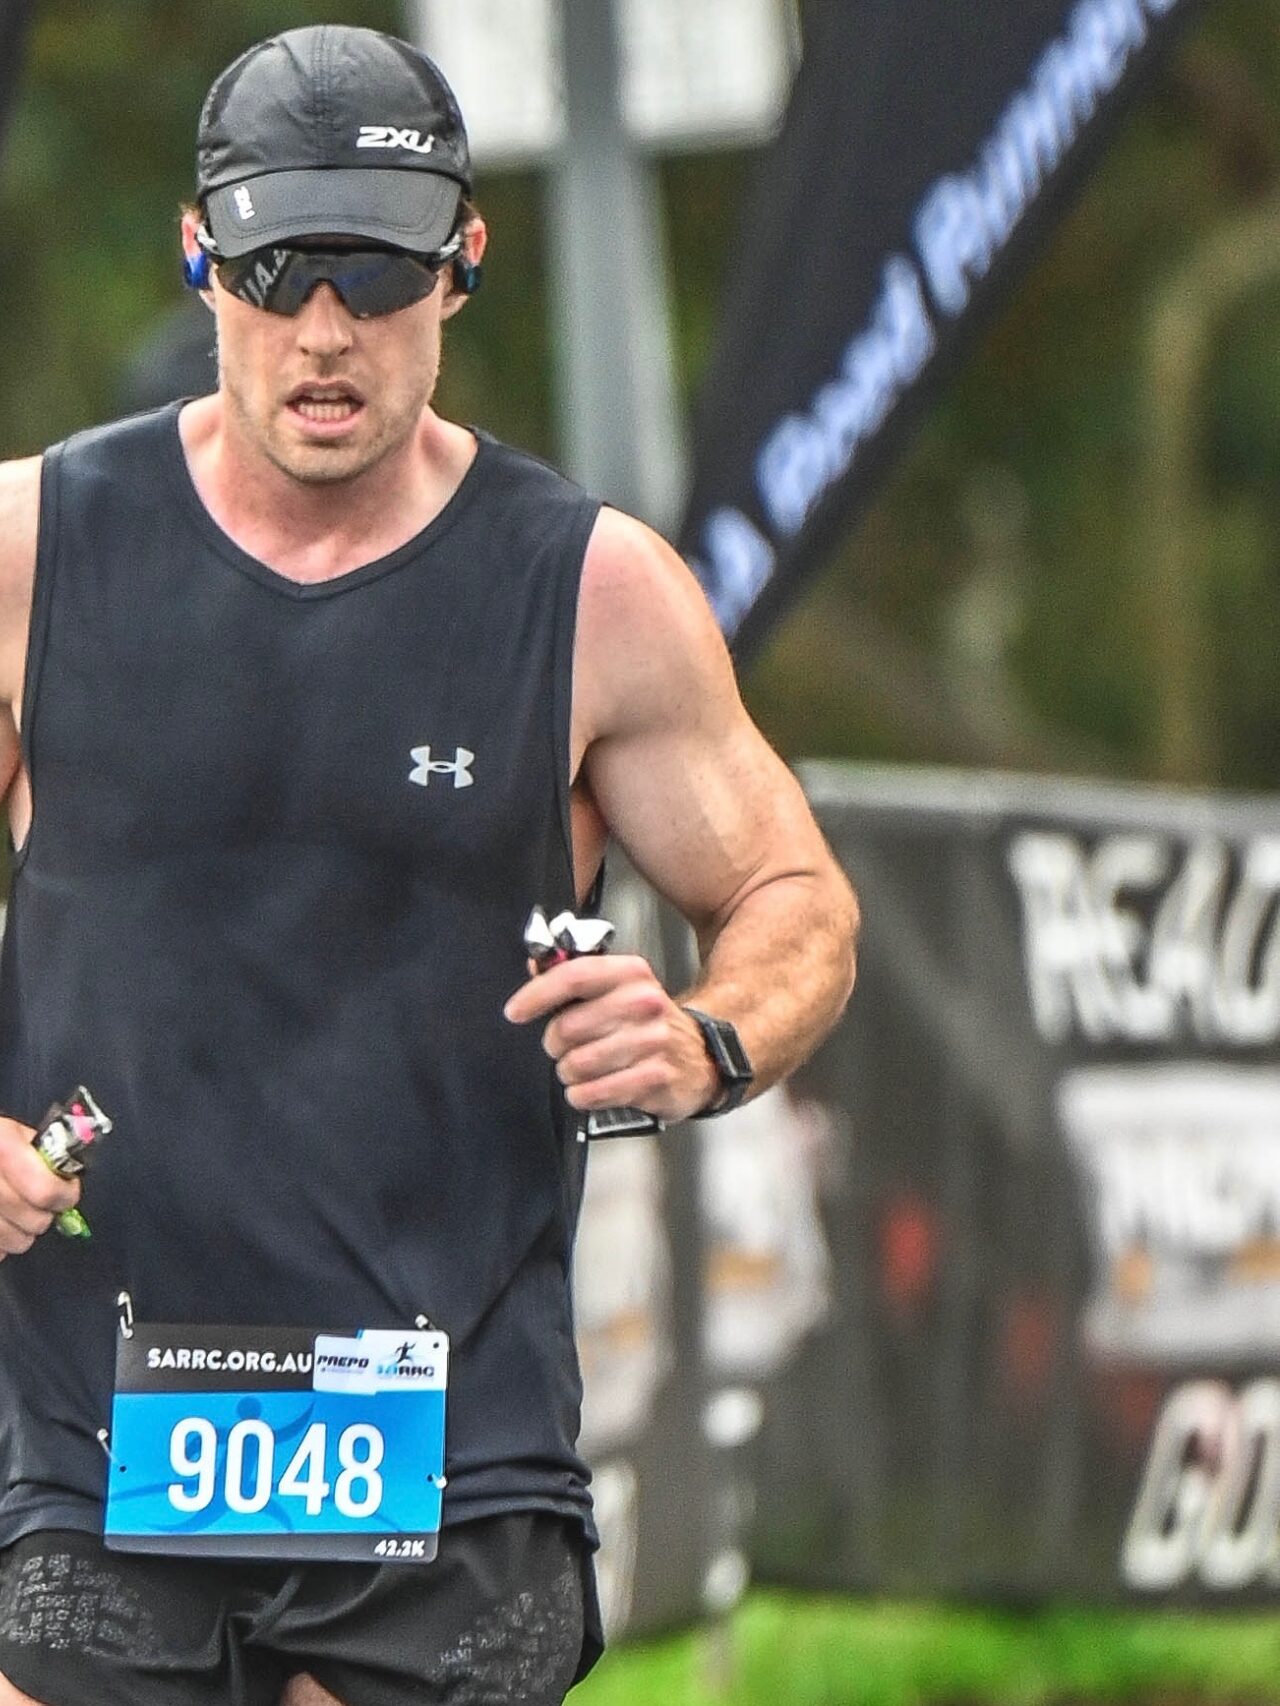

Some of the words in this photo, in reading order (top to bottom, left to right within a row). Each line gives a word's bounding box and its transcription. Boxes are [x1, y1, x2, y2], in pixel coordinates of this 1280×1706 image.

[147, 1348, 312, 1374] SARRC.ORG.AU
[168, 1417, 385, 1518] 9048
[374, 1539, 425, 1557] 42.2K
